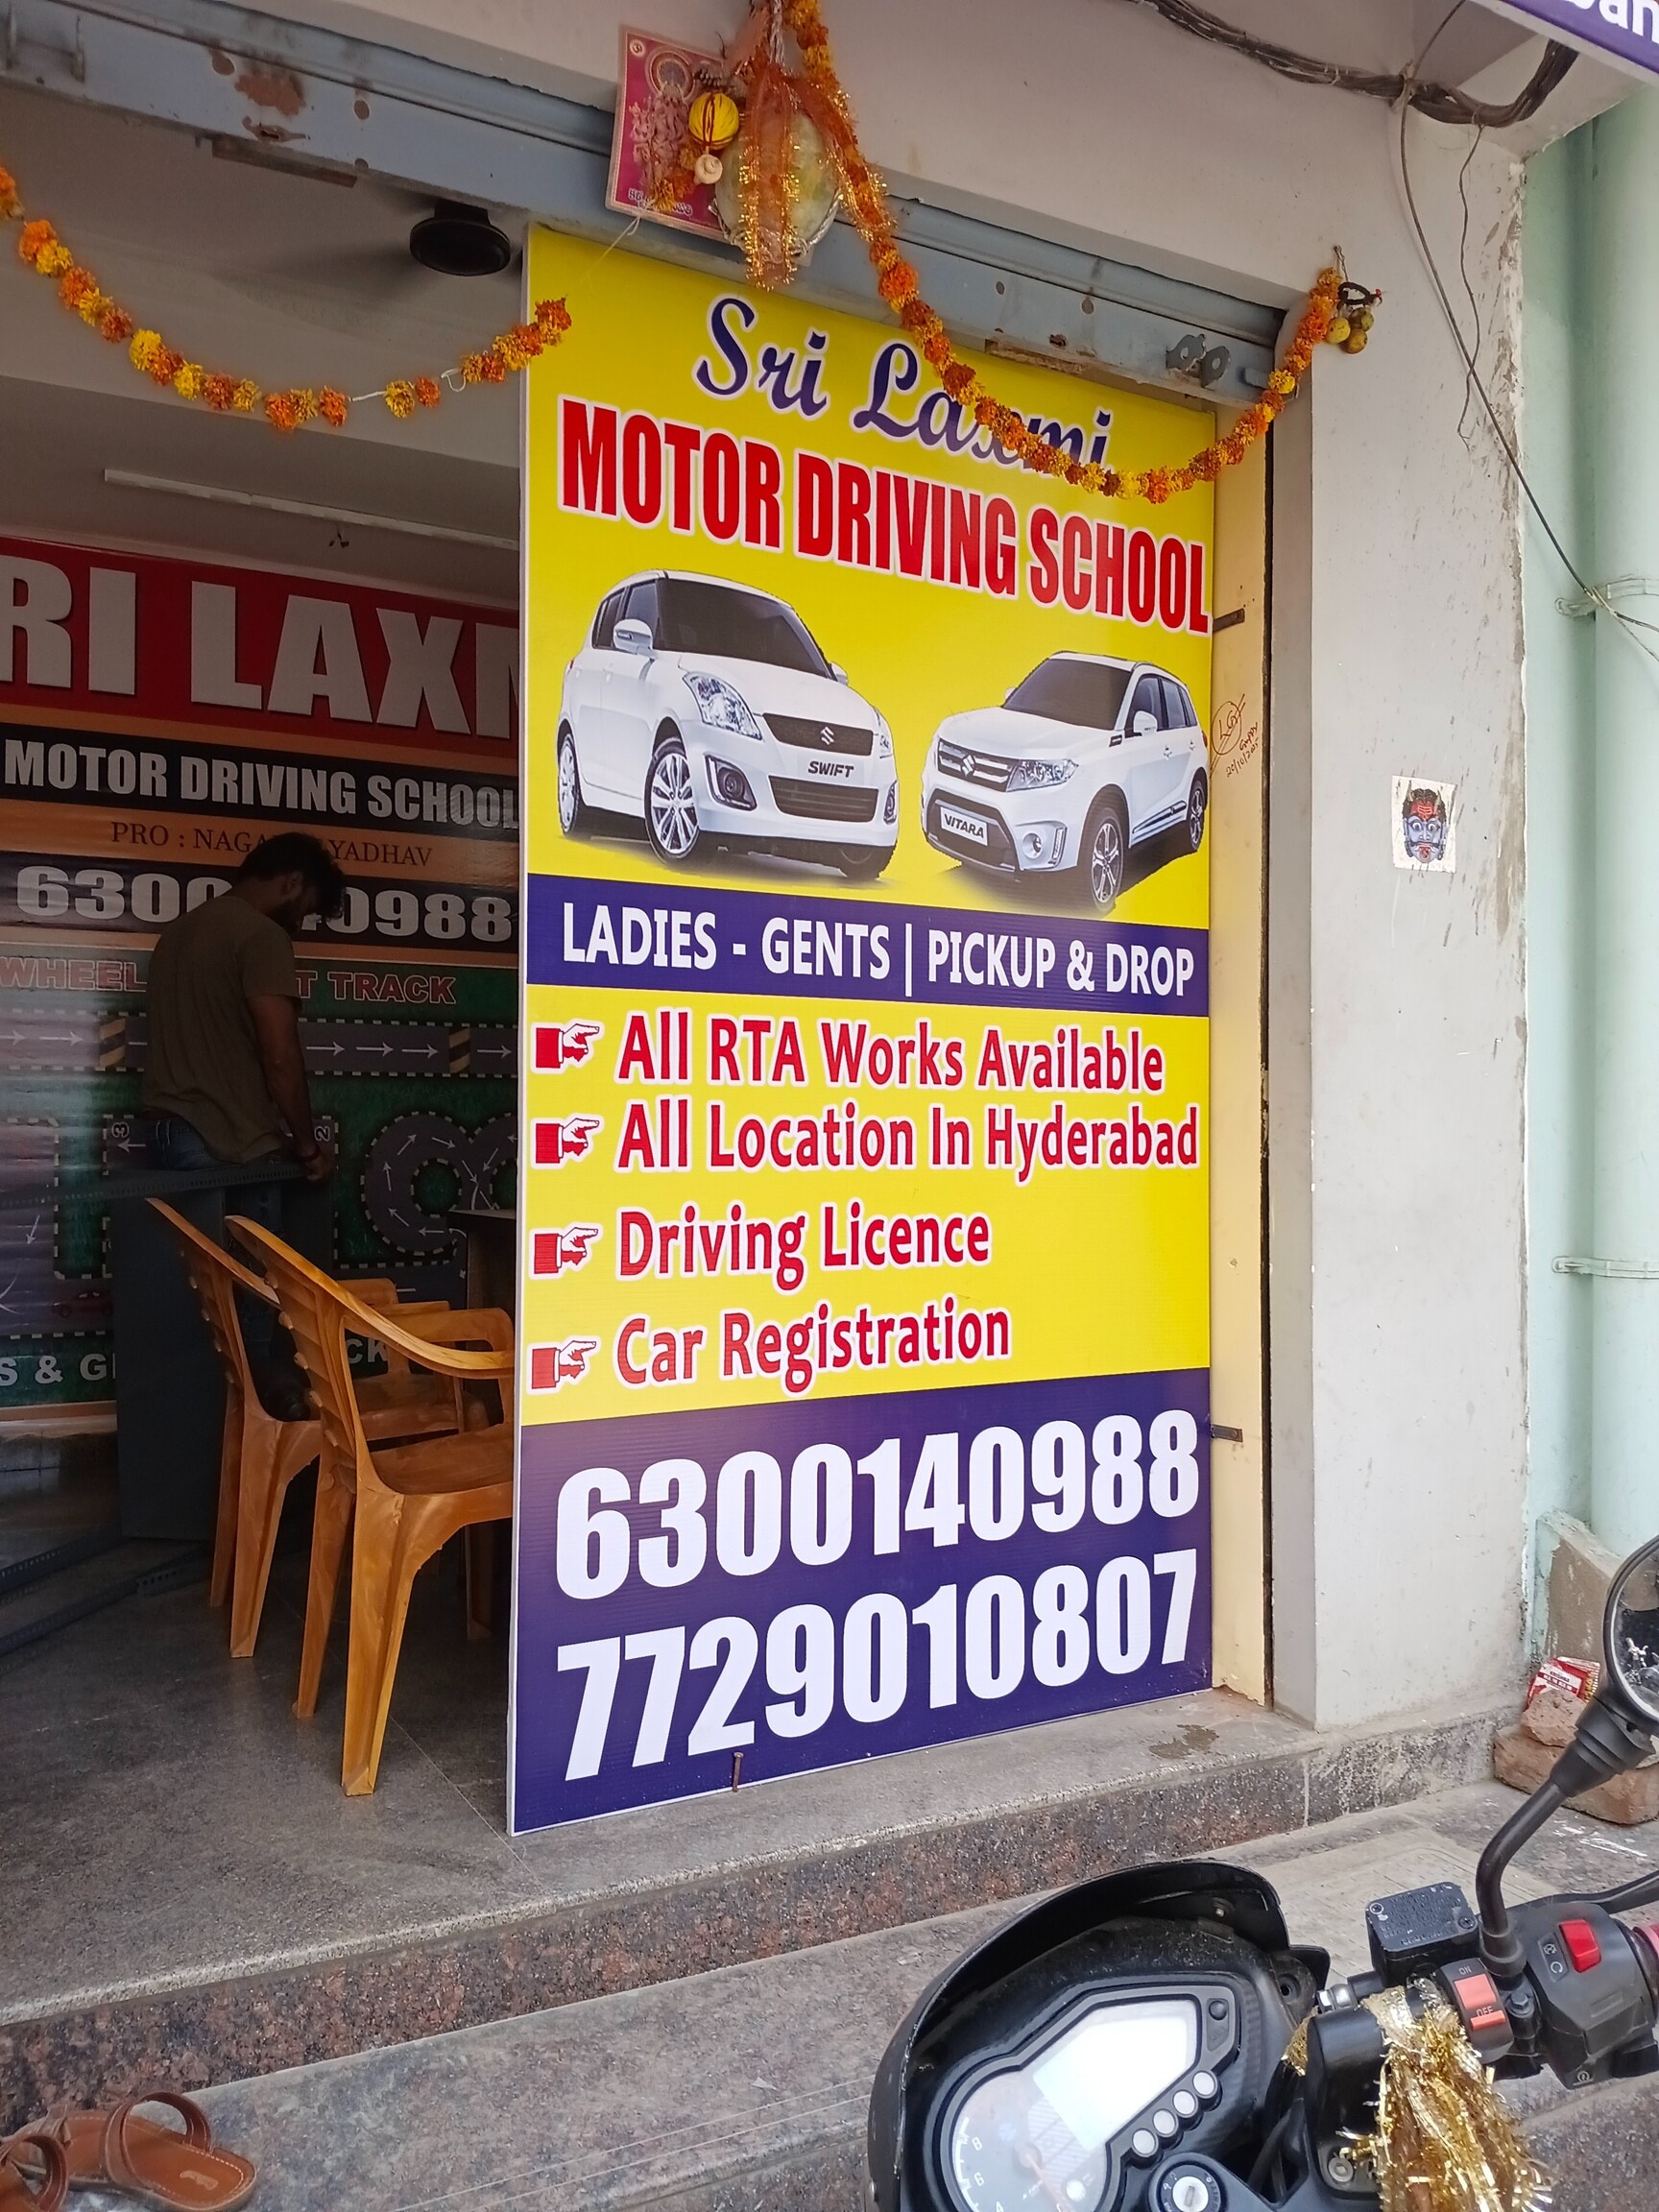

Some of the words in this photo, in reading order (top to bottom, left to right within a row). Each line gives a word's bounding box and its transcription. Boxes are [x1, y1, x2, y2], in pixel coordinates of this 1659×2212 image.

[1564, 0, 1659, 44] an
[697, 299, 827, 416] Sri
[563, 399, 781, 548] MOTOR
[798, 452, 1016, 595] DRIVING
[1030, 508, 1210, 634] SCHOOL
[4, 738, 167, 798] MOTOR
[180, 756, 356, 814] DRIVING
[368, 775, 518, 830] SCHOOL
[807, 760, 854, 778] SWIFT
[111, 821, 169, 847] PRO
[328, 838, 433, 867] YADHAV
[944, 813, 984, 838] VITARA
[16, 865, 513, 943] 63000988
[327, 971, 457, 1004] TRACK
[563, 902, 718, 971] LADIES
[761, 917, 891, 980] GENTS
[928, 928, 1056, 989] PICKUP
[1066, 939, 1095, 992] &
[1106, 943, 1194, 997] DROP
[617, 1011, 689, 1080] All
[710, 1018, 805, 1083] RTA
[820, 1022, 963, 1086] Works
[977, 1028, 1164, 1092] Available
[617, 1098, 689, 1168] All
[710, 1102, 914, 1168] Location
[932, 1107, 970, 1166] In
[988, 1106, 1197, 1183] Hyderabad
[619, 1204, 805, 1291] Driving
[824, 1201, 989, 1266] Licence
[616, 1318, 705, 1384] Car
[723, 1297, 1009, 1393] Registration
[556, 1409, 1199, 1599] 6300140988
[558, 1548, 1197, 1782] 7729010807
[1458, 1965, 1473, 1975] ON
[972, 2136, 983, 2152] 8
